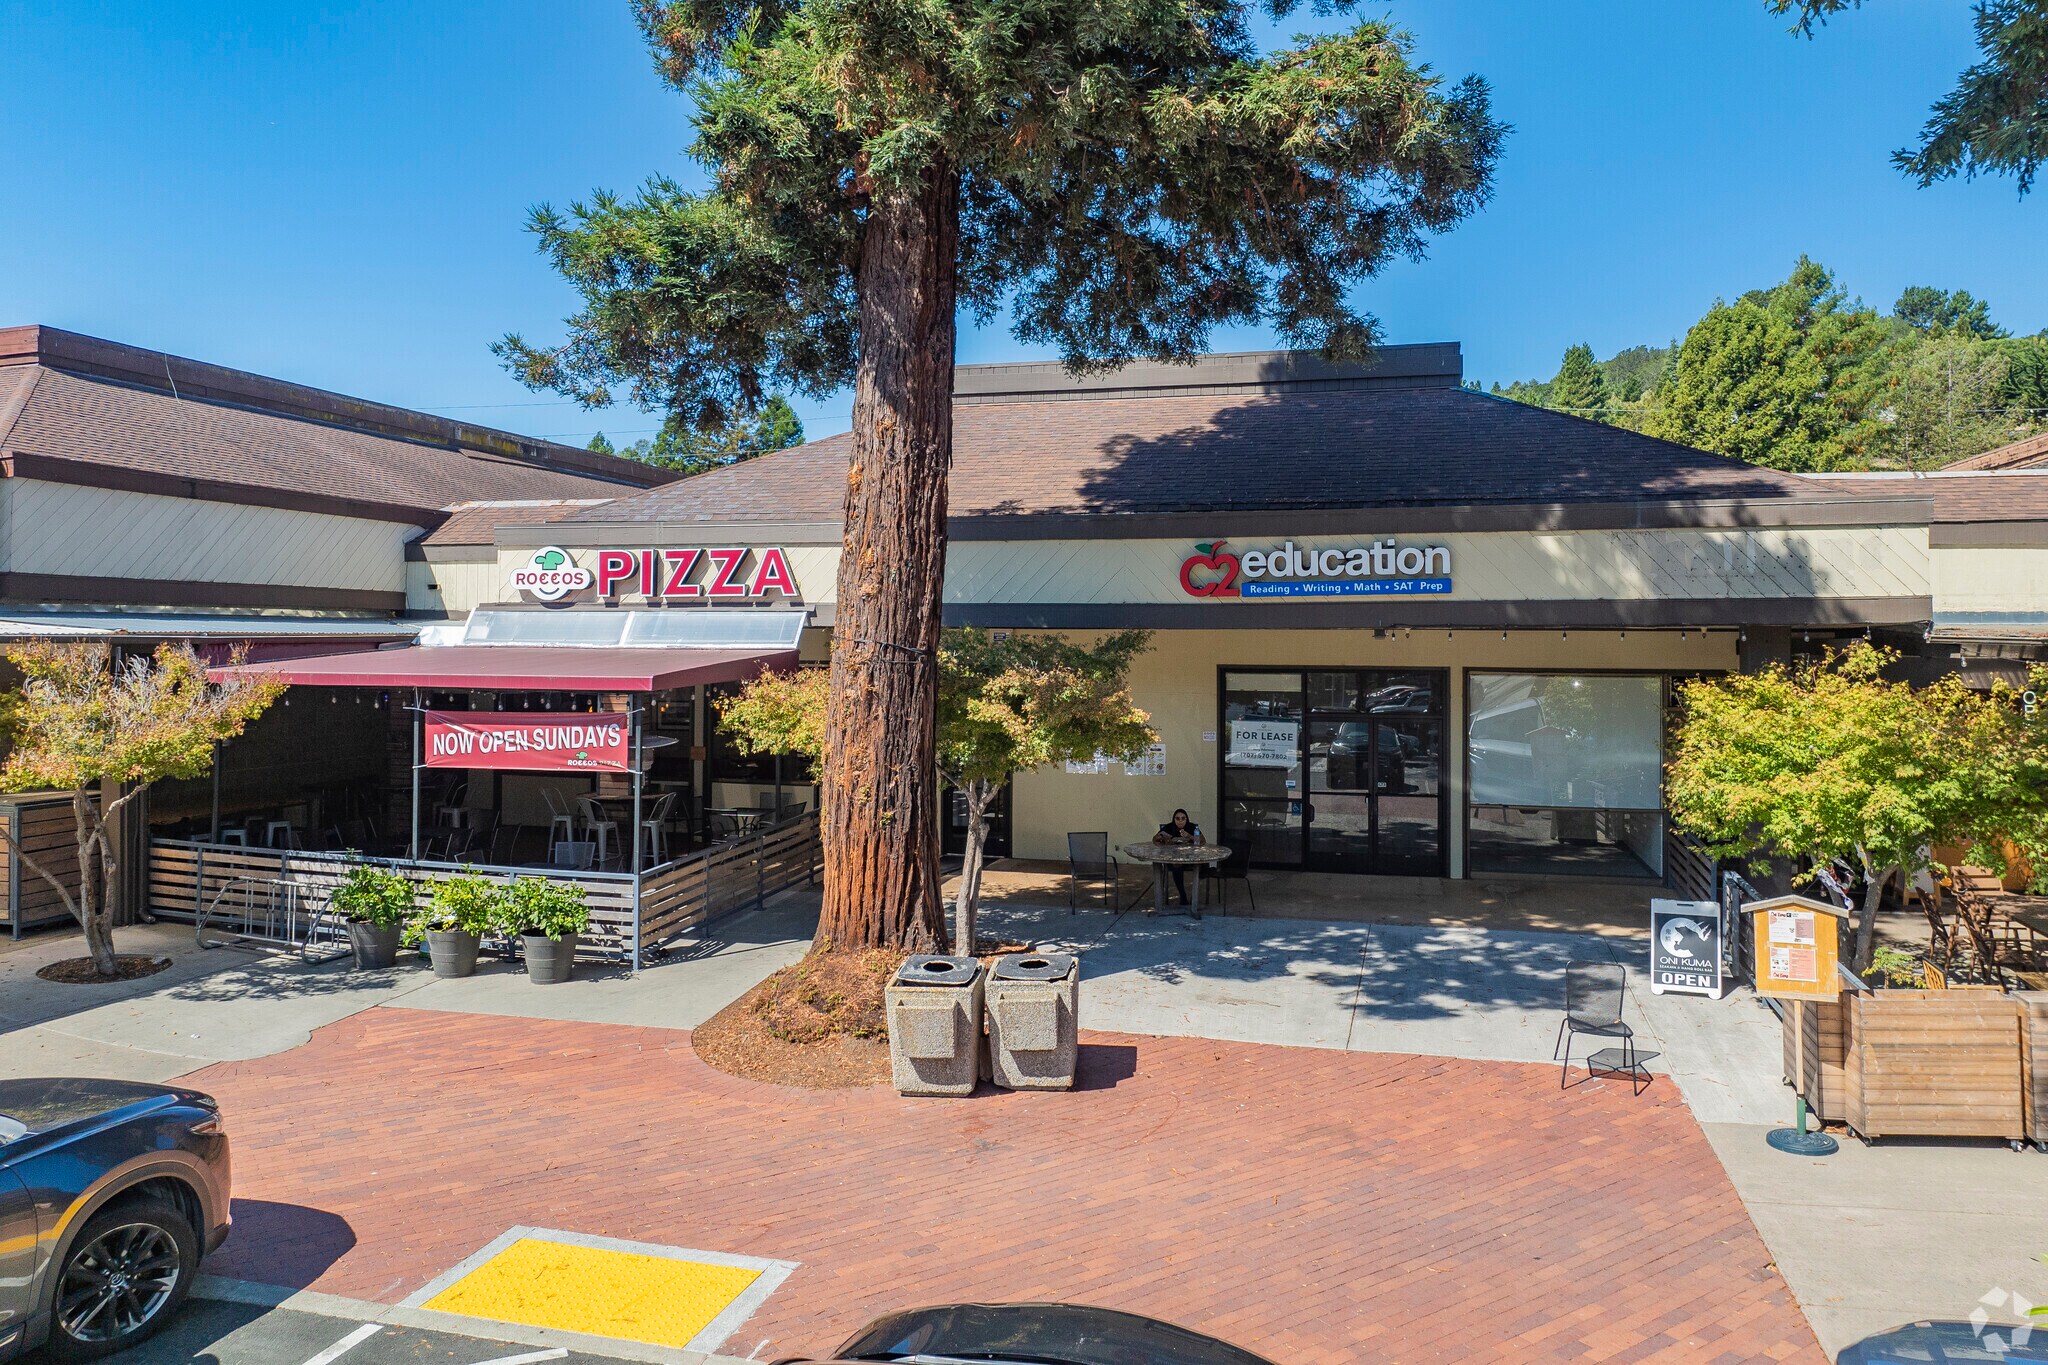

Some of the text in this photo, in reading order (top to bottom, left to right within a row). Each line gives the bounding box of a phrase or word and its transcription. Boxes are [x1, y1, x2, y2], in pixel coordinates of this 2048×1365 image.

[597, 547, 798, 597] PIZZA
[1179, 538, 1451, 597] C2 education
[1250, 581, 1443, 595] Reading Writing Math SAT Prep
[433, 723, 621, 756] NOW OPEN SUNDAYS
[1236, 731, 1294, 741] FOR LEASE
[1659, 956, 1713, 968] ONI KUMA
[1661, 972, 1711, 987] OPEN
